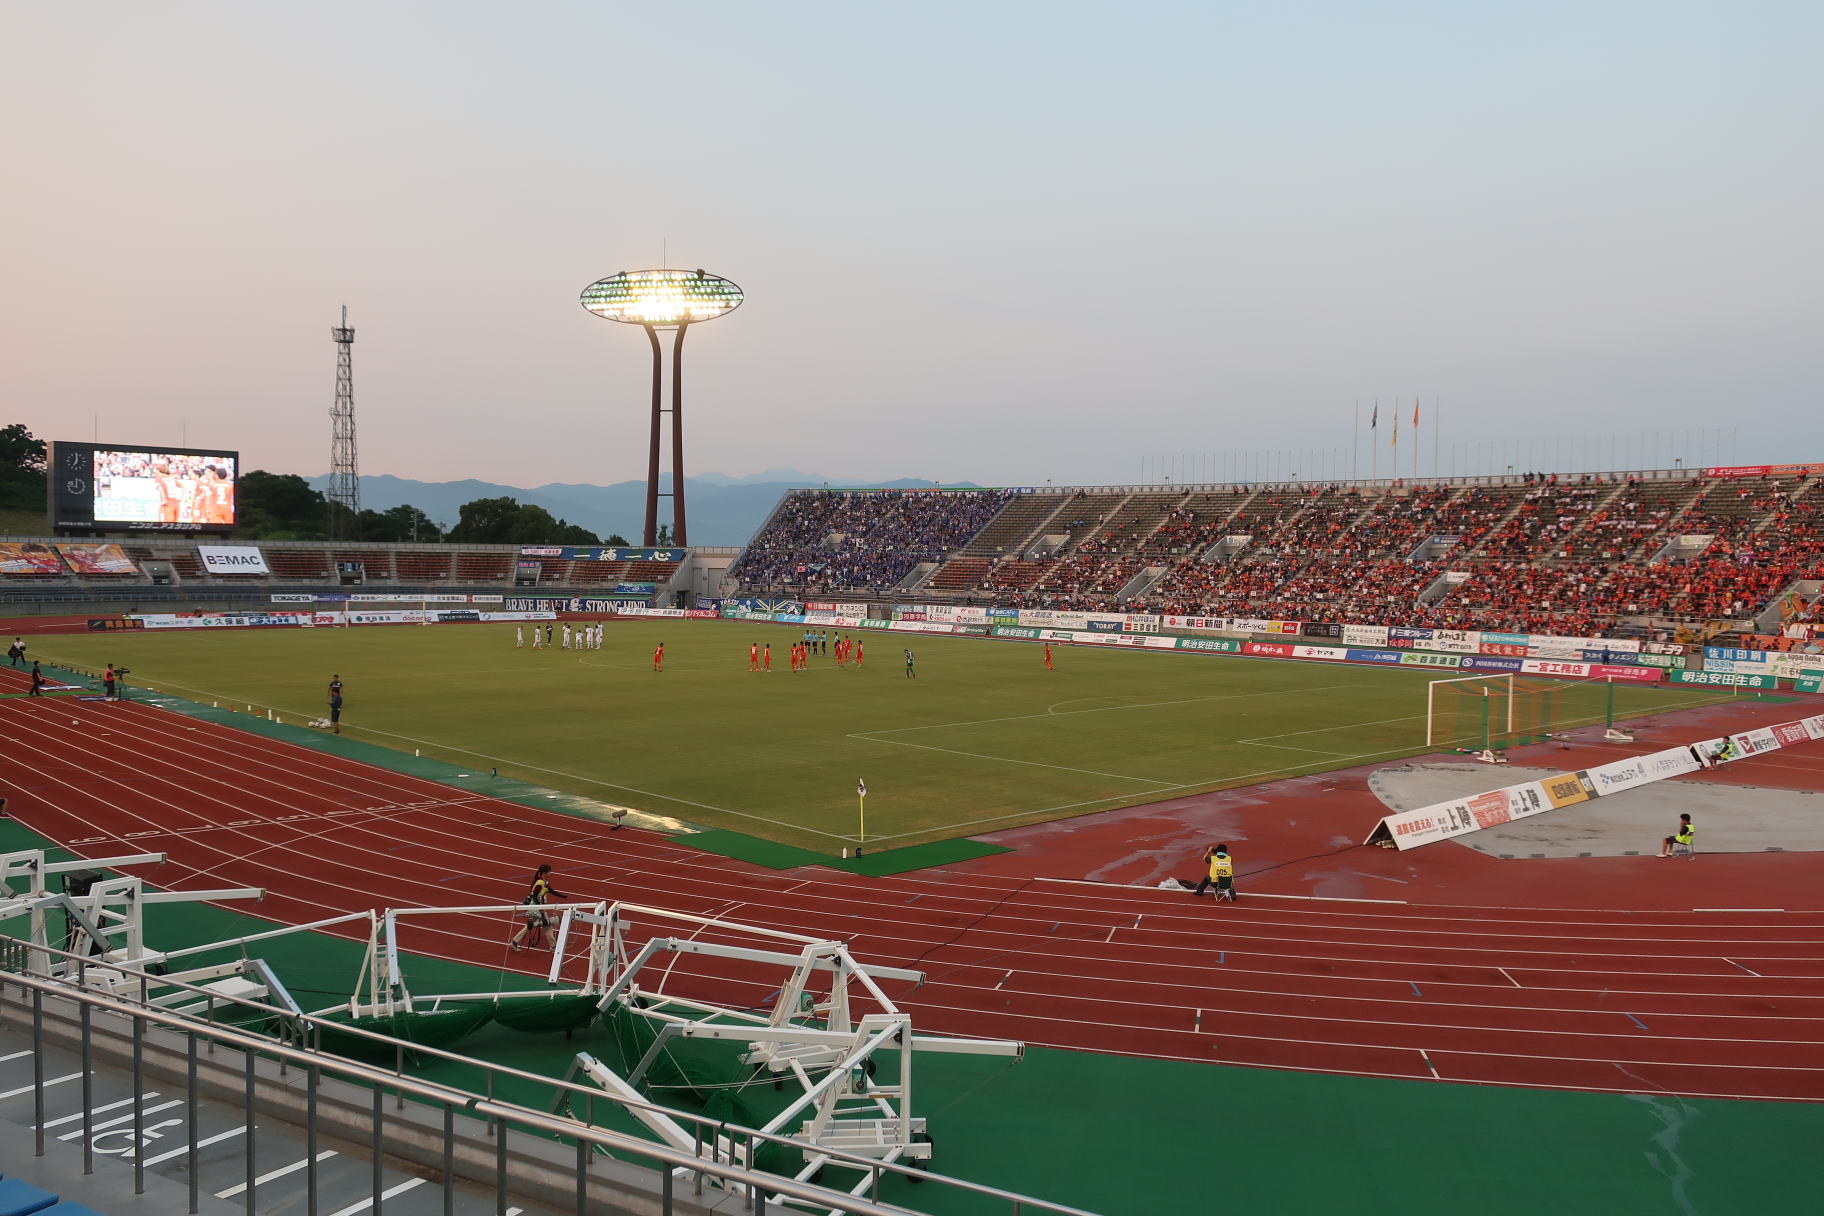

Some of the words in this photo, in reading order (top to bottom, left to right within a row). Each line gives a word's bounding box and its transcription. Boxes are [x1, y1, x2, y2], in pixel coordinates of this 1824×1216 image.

[207, 554, 261, 566] BEMAC
[506, 598, 535, 611] BRAVE
[536, 599, 568, 611] HEAT
[585, 600, 621, 612] STRONG
[215, 617, 245, 625] 久保組
[1186, 618, 1223, 629] 朝日新聞
[1236, 622, 1267, 631] スポーツくじ
[1181, 640, 1230, 650] 明治安田生命
[1708, 648, 1762, 661] 佐川印刷
[1527, 662, 1584, 674] 一宮工務店
[1682, 672, 1763, 687] 明治安田生命
